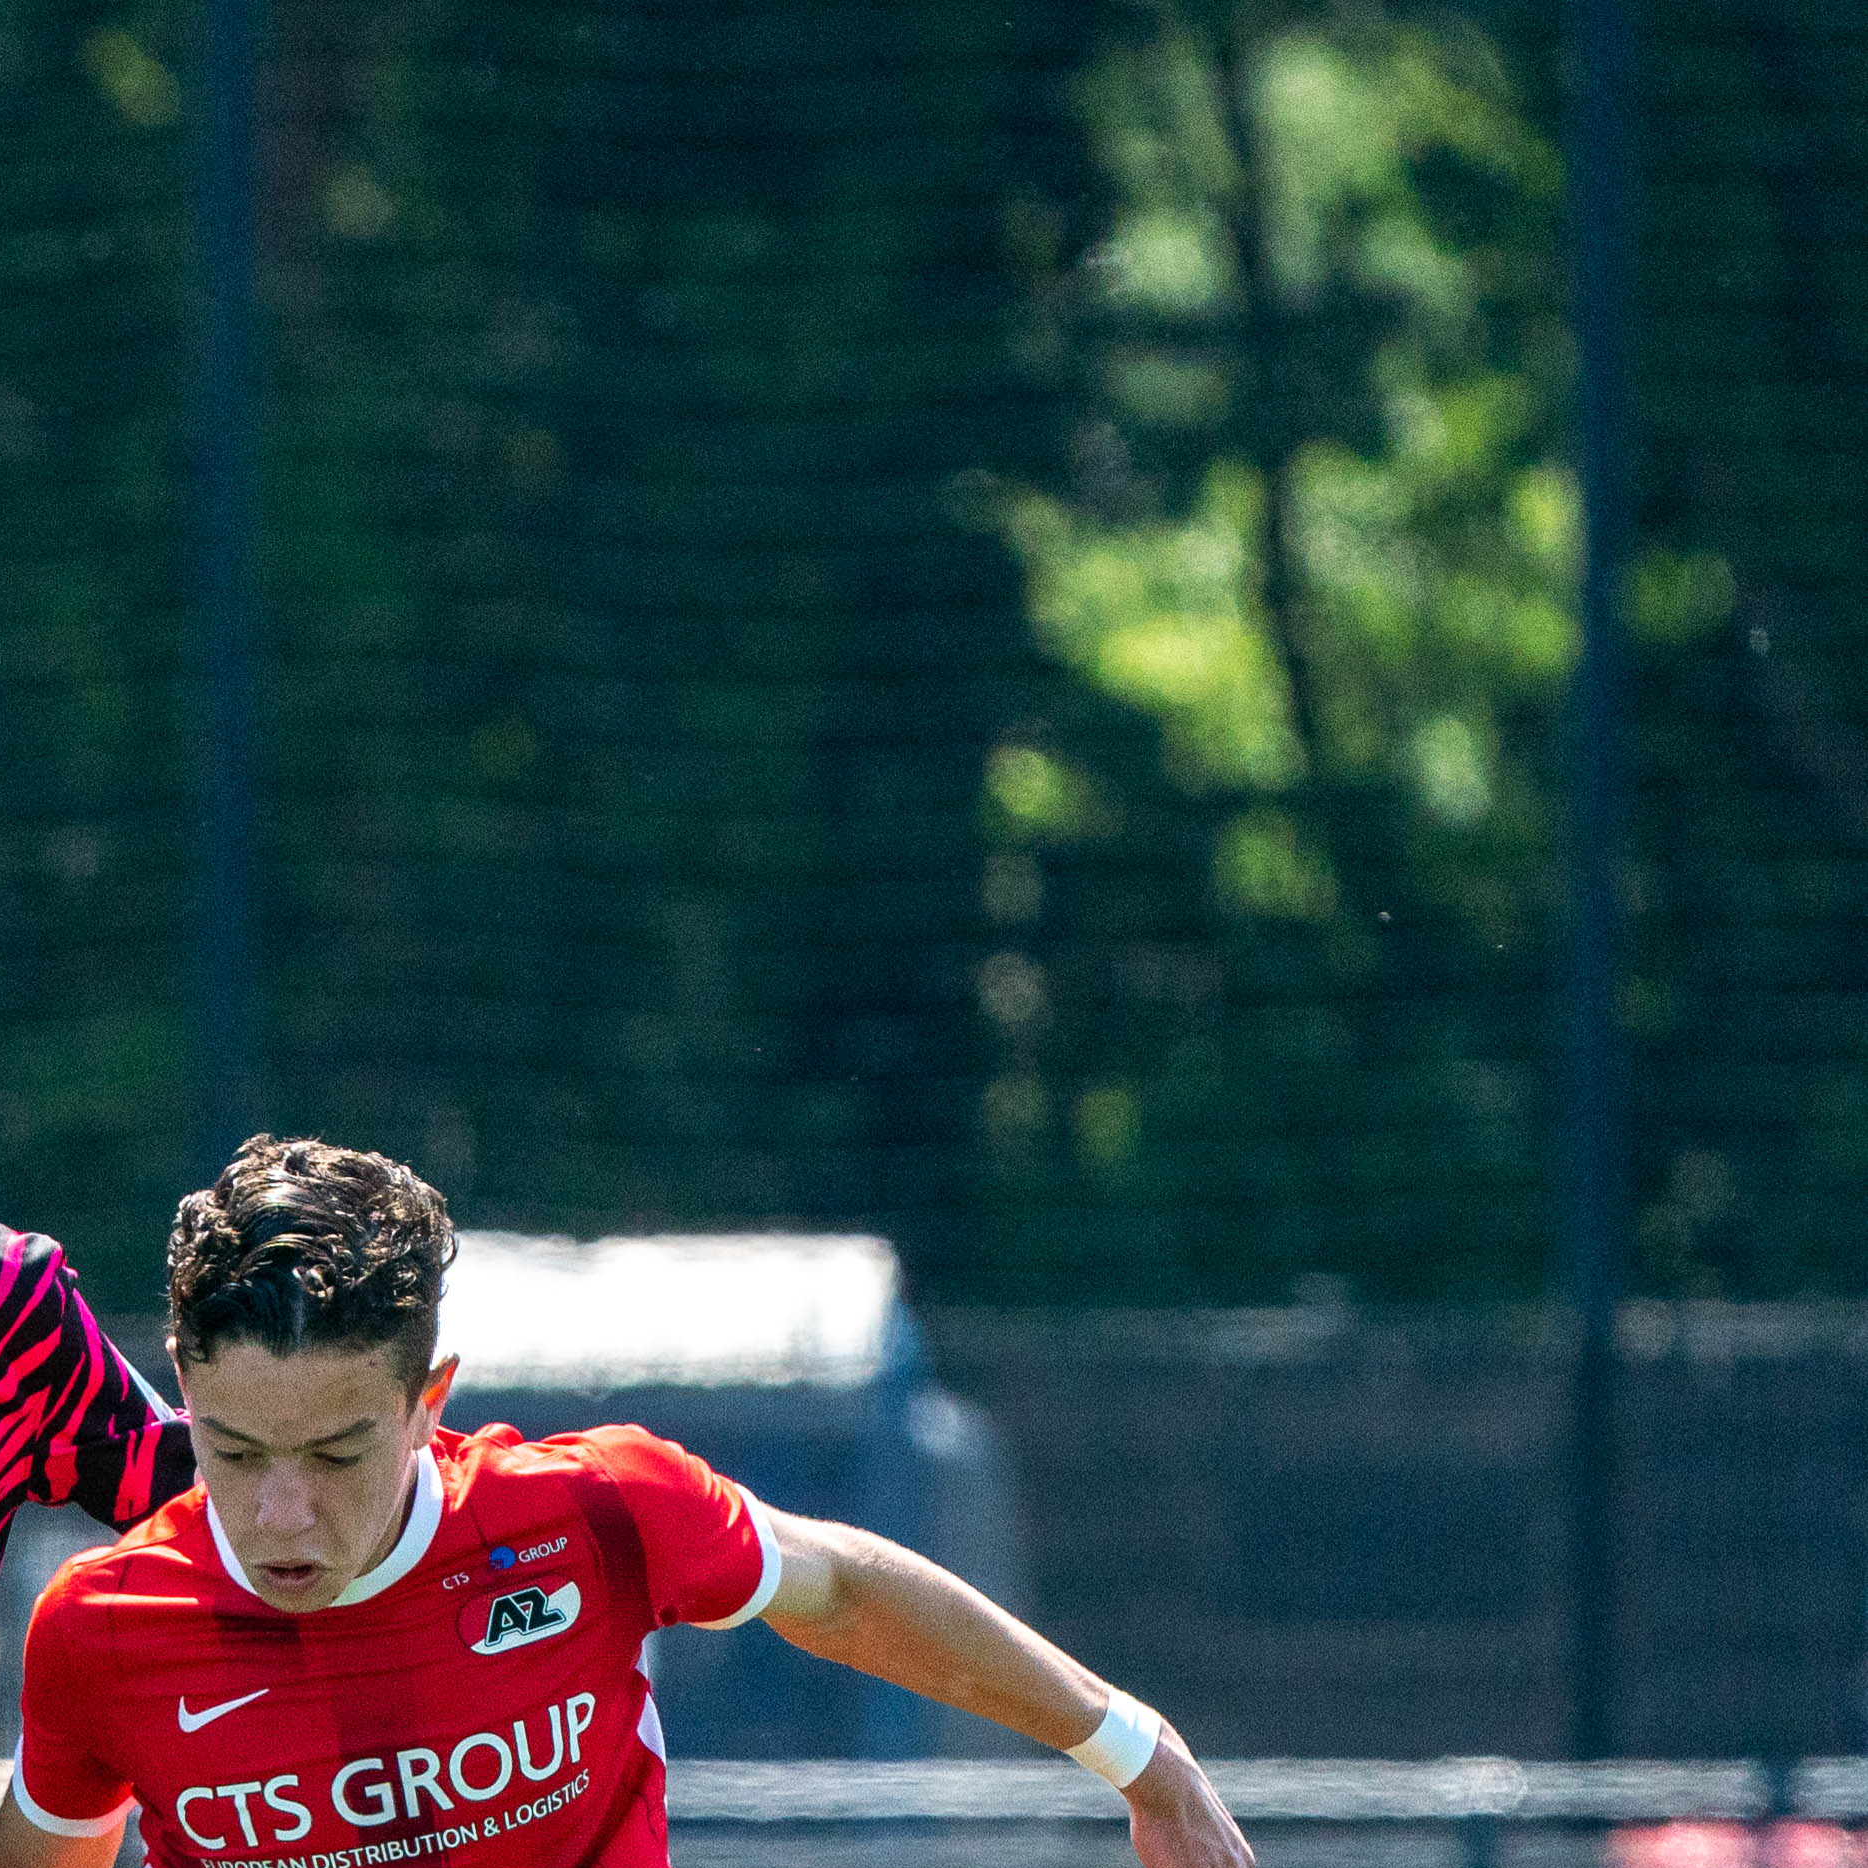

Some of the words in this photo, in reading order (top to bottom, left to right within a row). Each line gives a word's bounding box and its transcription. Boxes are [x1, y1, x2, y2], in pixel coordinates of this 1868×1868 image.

[442, 1572, 470, 1590] CTS
[518, 1536, 568, 1563] GROUP
[485, 1586, 567, 1647] AZ
[175, 1774, 313, 1850] CTS
[330, 1691, 596, 1827] GROUP
[482, 1816, 501, 1838] &
[503, 1768, 591, 1831] LOGISTICS
